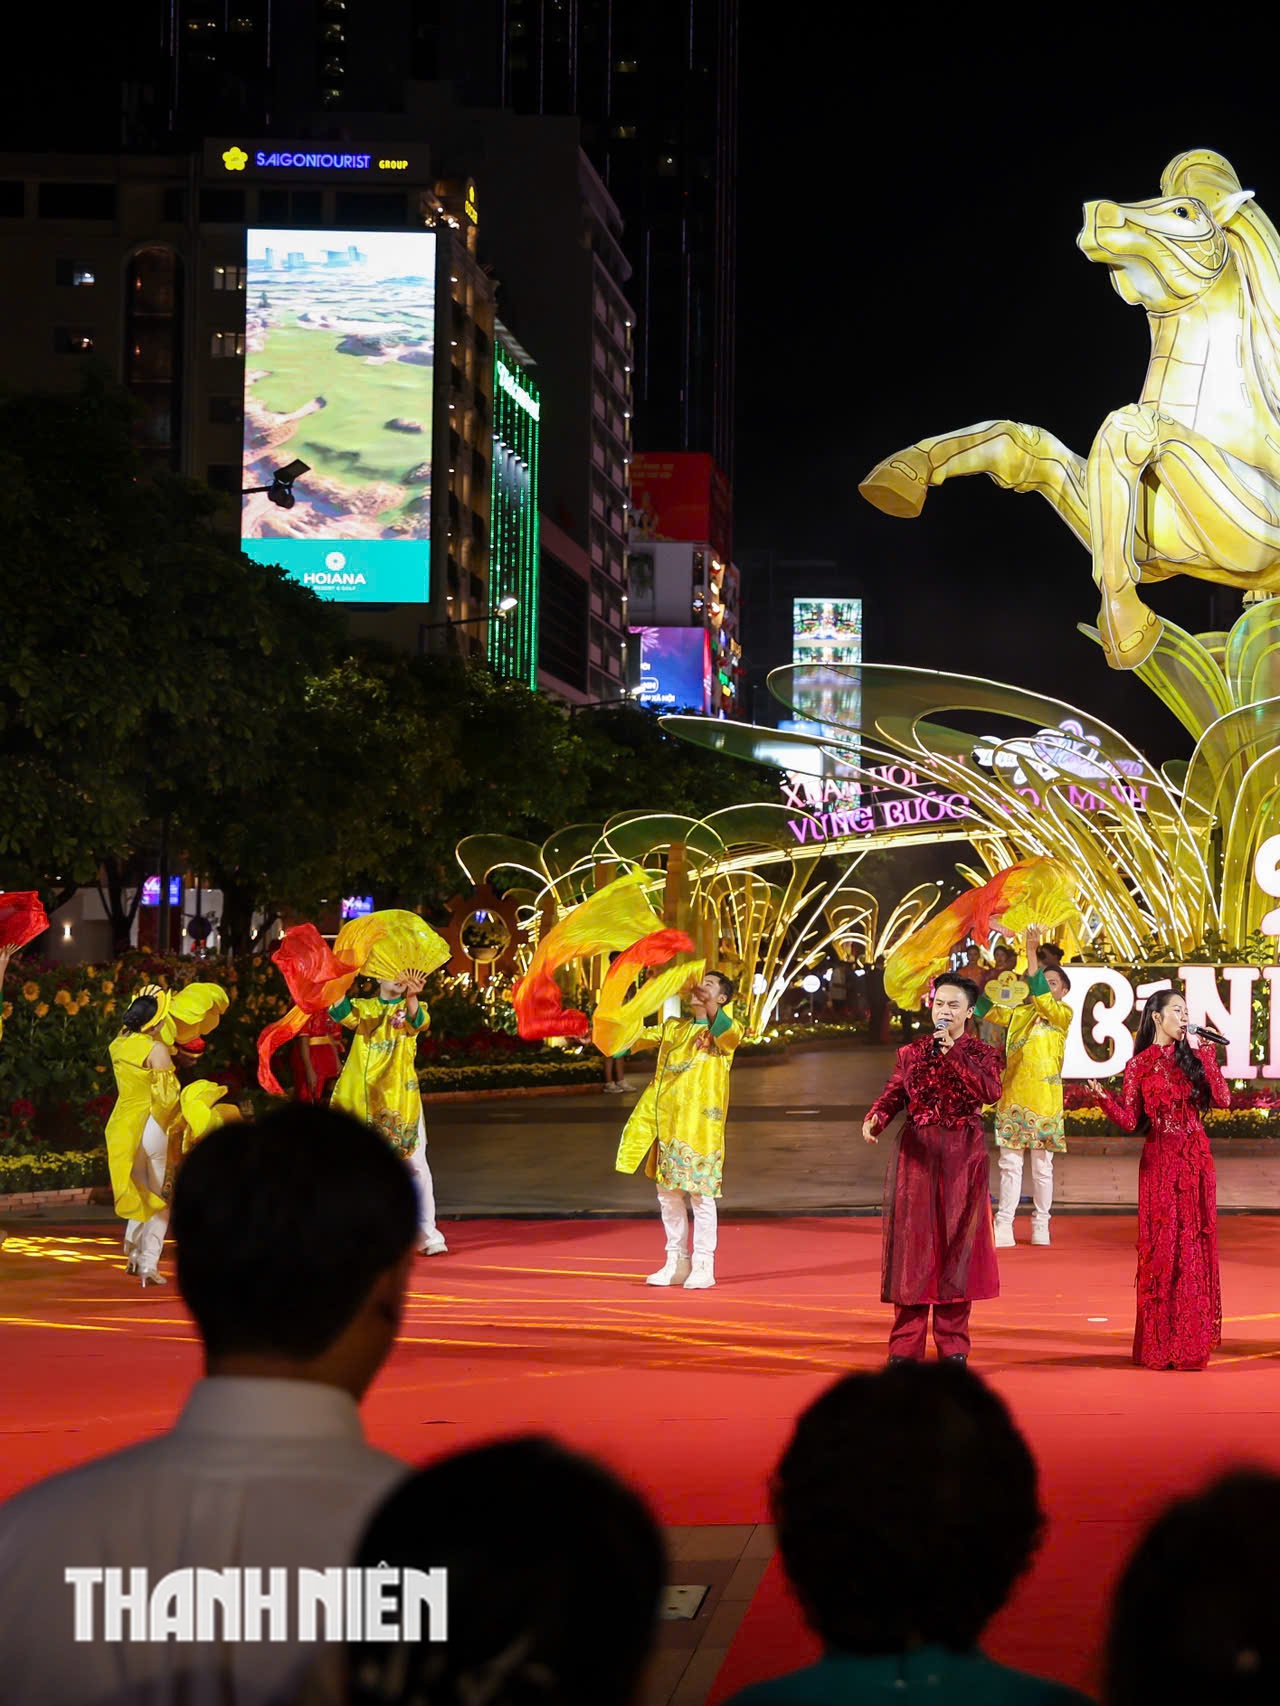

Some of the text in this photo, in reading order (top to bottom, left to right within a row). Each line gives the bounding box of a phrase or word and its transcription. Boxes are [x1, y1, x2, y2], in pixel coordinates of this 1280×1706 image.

[256, 151, 408, 170] SAIGONTOURIST GROUP
[303, 572, 367, 585] HOIANA
